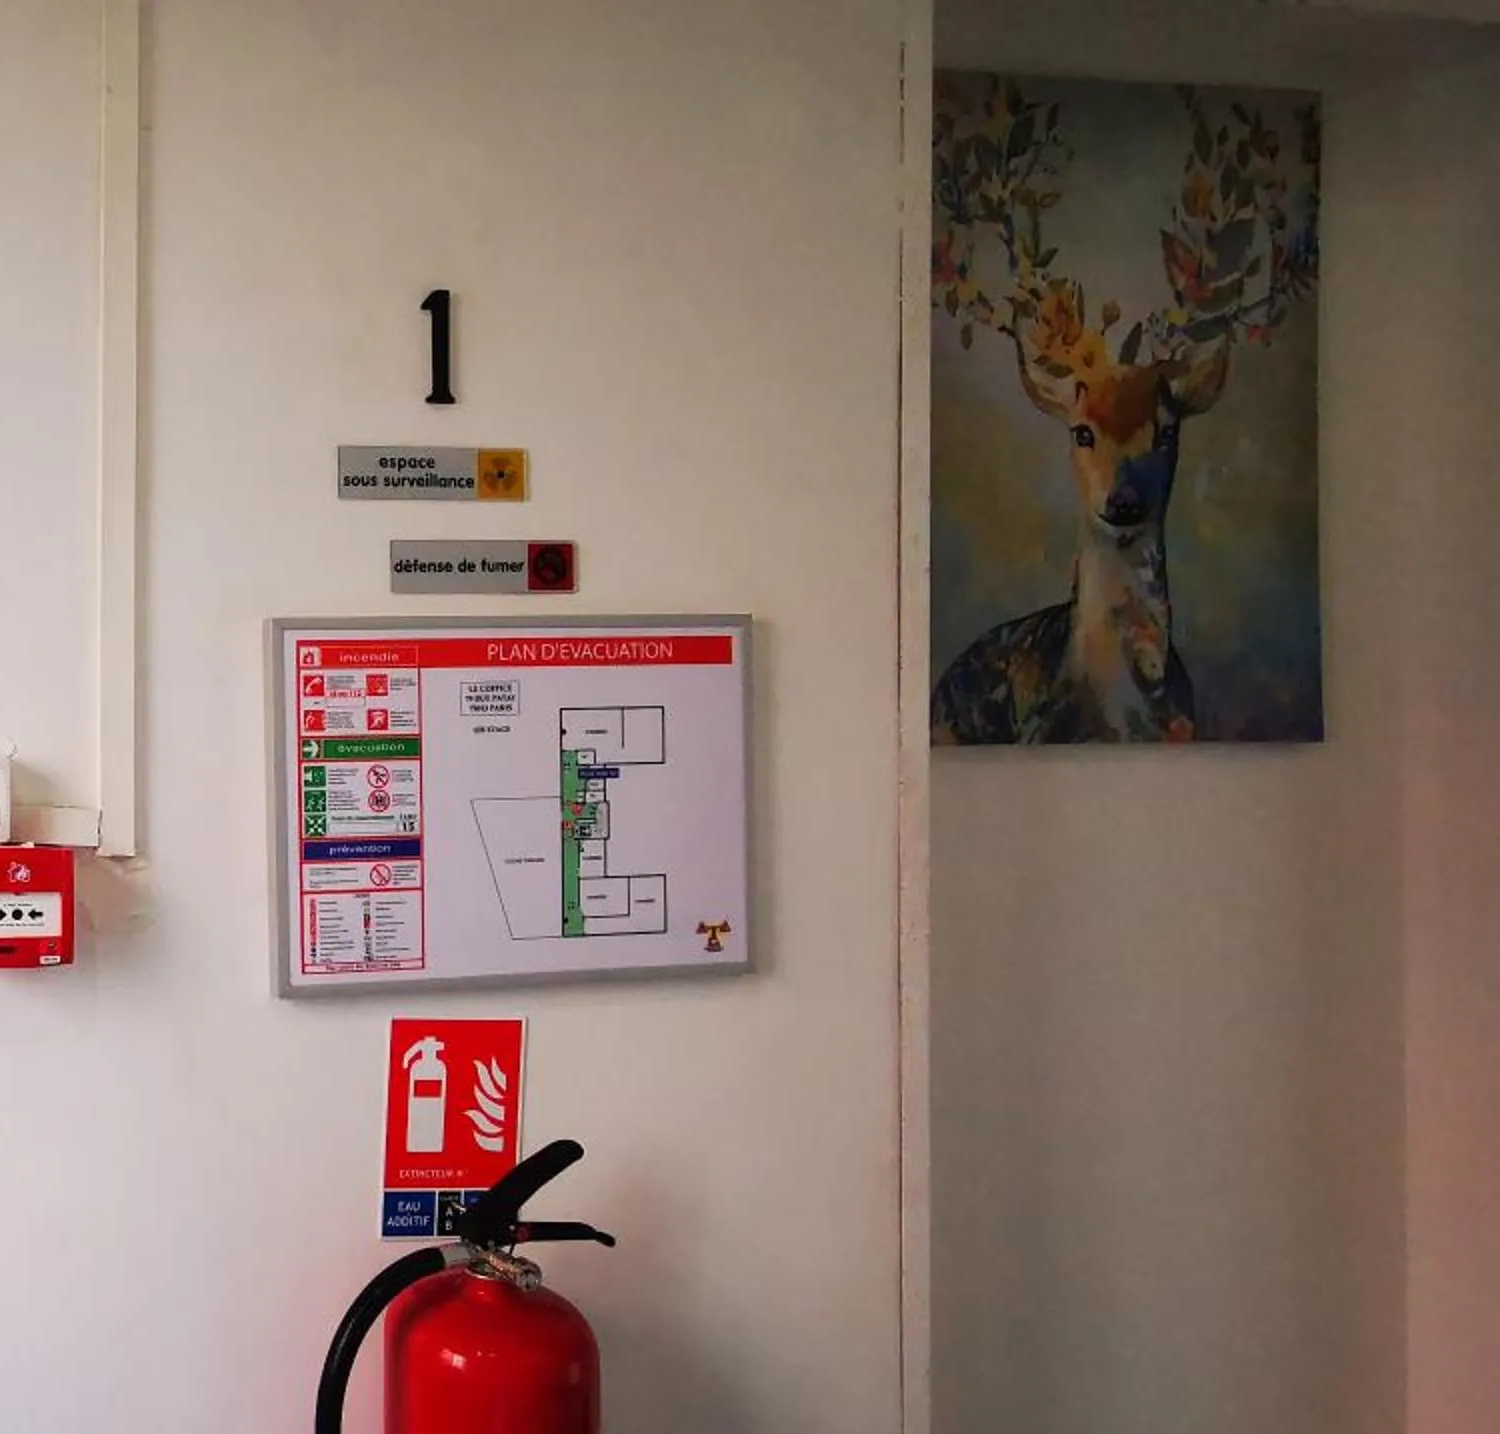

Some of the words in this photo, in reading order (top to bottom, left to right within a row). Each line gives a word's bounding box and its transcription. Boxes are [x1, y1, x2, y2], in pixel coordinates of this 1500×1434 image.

[420, 289, 456, 404] 1
[378, 456, 436, 471] espace
[343, 473, 378, 487] sous
[383, 473, 475, 490] surveillance
[394, 559, 453, 574] défense
[457, 559, 477, 574] de
[481, 559, 525, 574] fumer
[339, 651, 400, 663] incendie
[487, 642, 537, 661] PLAN
[541, 640, 674, 661] D'EVACUATION
[402, 821, 416, 833] 15
[397, 1200, 421, 1213] EAU
[387, 1215, 431, 1228] ADDITIF
